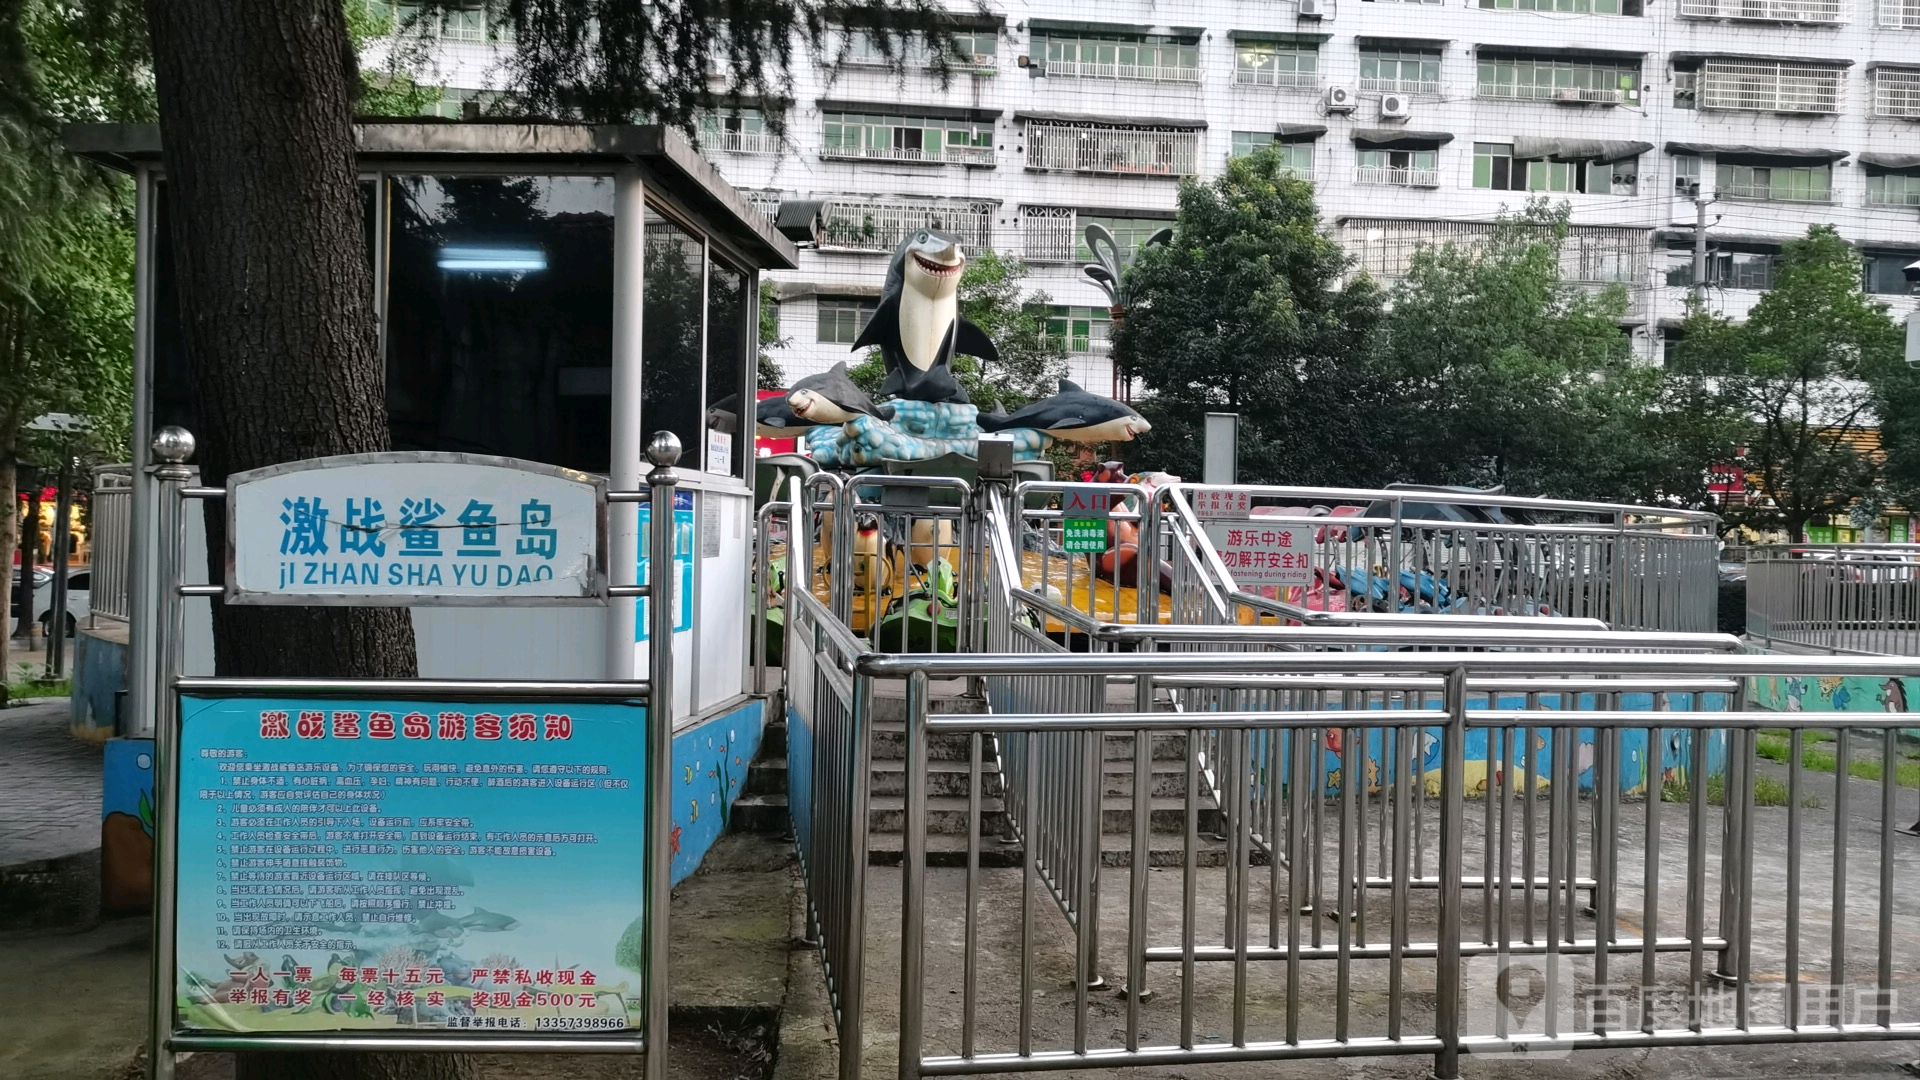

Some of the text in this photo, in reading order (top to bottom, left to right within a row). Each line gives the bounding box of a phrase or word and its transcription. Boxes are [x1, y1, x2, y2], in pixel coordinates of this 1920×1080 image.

[1066, 491, 1107, 511] 入口
[1197, 491, 1247, 500] 拒收现金
[1197, 501, 1247, 510] 举报有奖
[279, 496, 558, 560] 激战鲨鱼岛
[1065, 529, 1105, 538] 免洗消毒液
[1065, 540, 1105, 549] 请合理使用
[1227, 529, 1293, 548] 游乐中途
[303, 562, 380, 585] ZHAN
[388, 563, 443, 586] SHA
[452, 563, 489, 586] YU
[496, 564, 553, 587] DAO
[1264, 571, 1286, 579] during
[1287, 571, 1307, 579] riding
[260, 711, 573, 741] 激战鲨鱼岛游客须知
[229, 966, 598, 987] 一人一票 每票十五元 严禁私收现金
[229, 988, 598, 1009] 举报有奖 一经核实 奖现金500元
